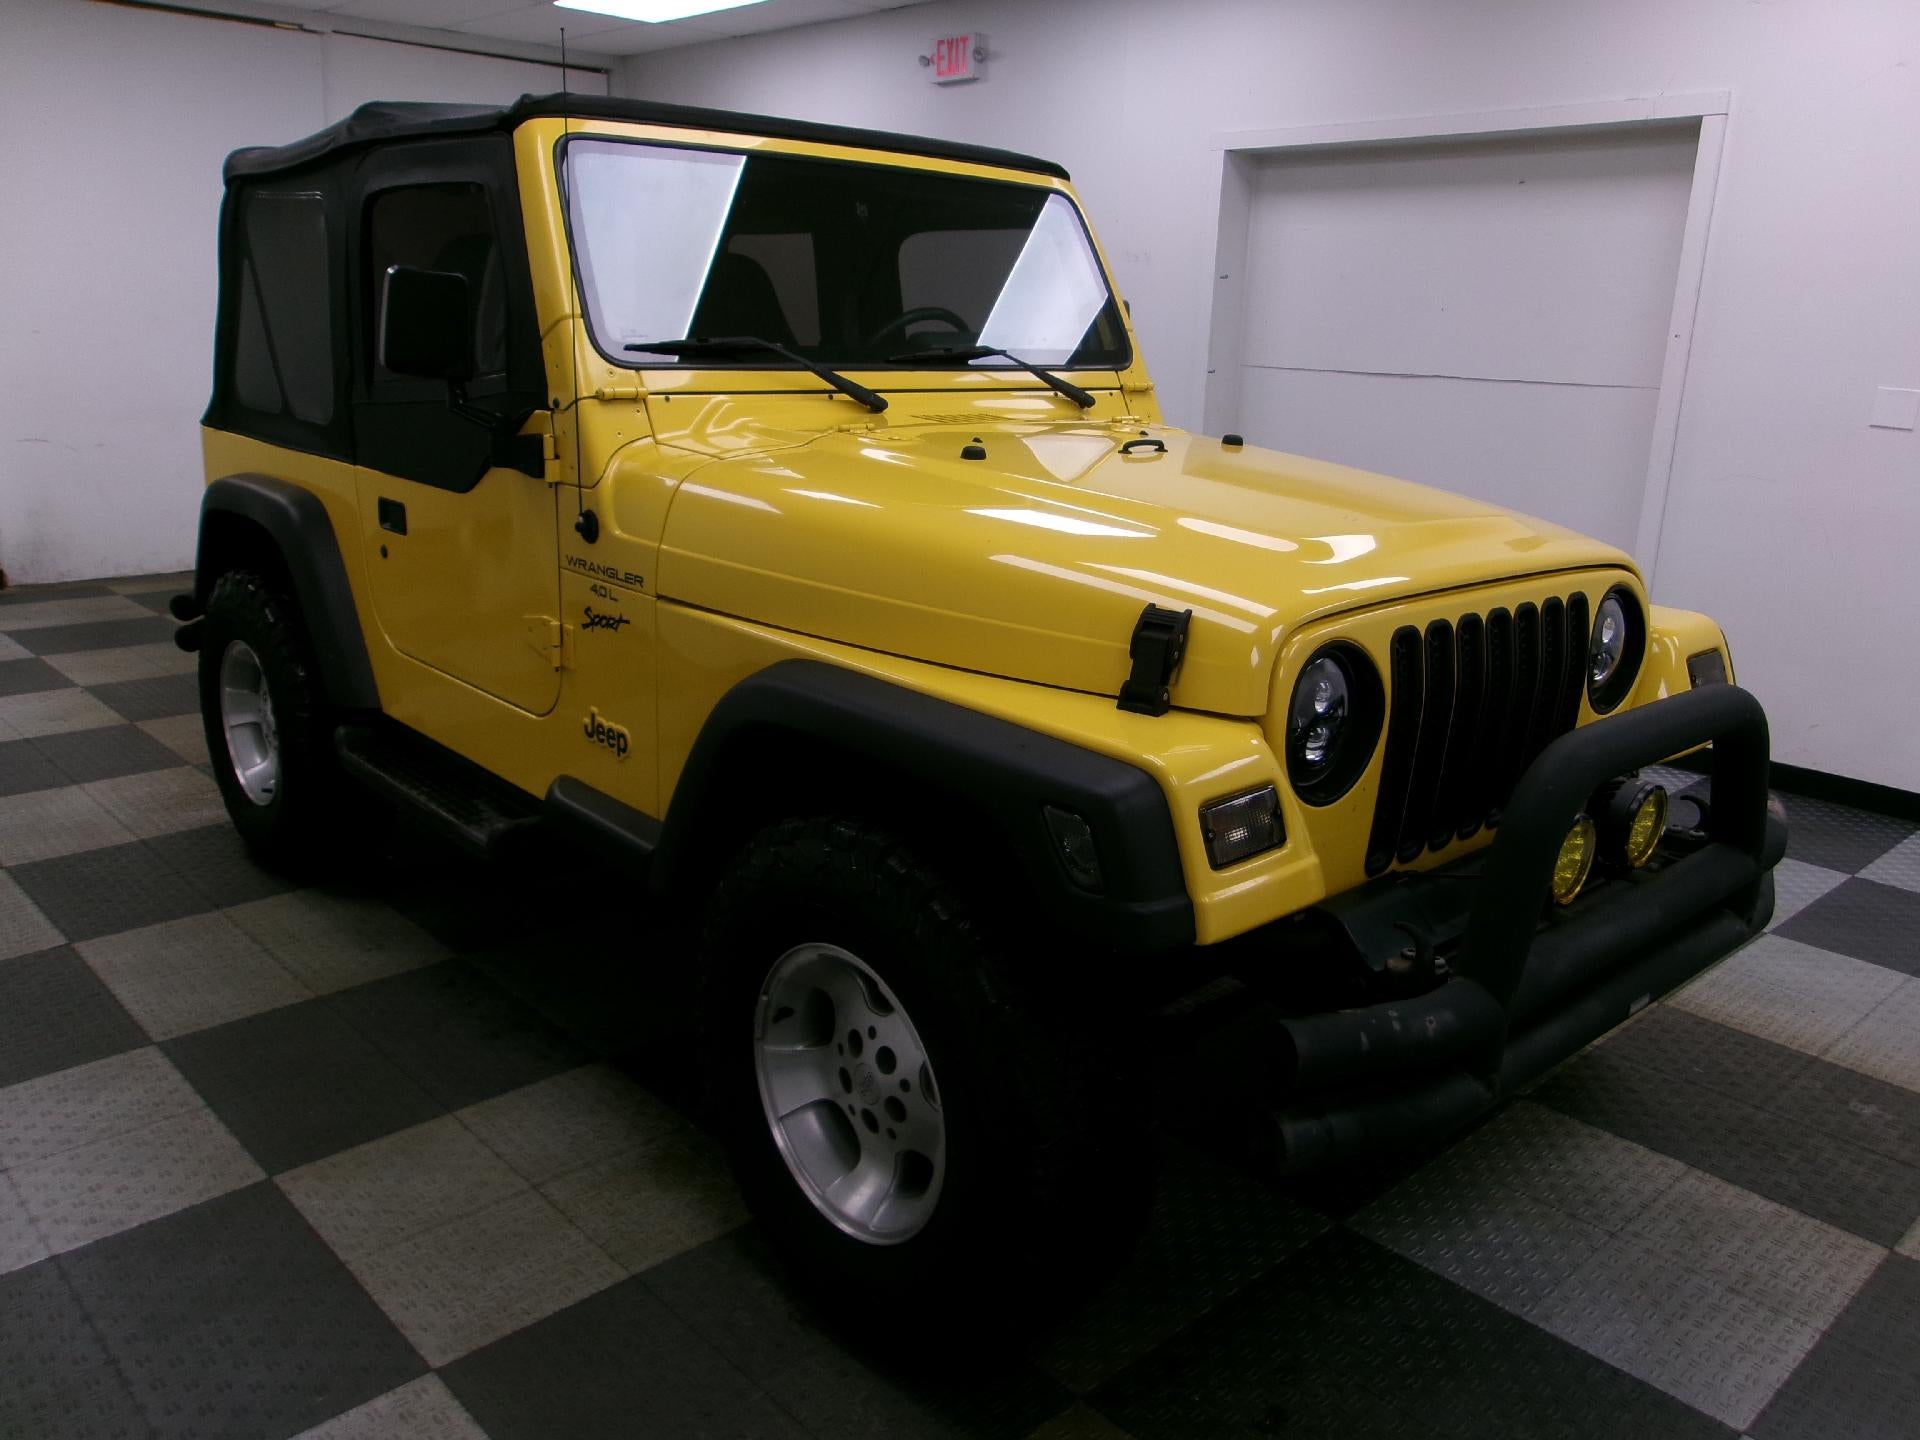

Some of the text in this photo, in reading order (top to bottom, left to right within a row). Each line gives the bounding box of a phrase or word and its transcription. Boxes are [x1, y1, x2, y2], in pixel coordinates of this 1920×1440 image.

[936, 36, 969, 76] EXIT
[566, 554, 644, 588] WRANGLER
[583, 708, 629, 758] Jeep
